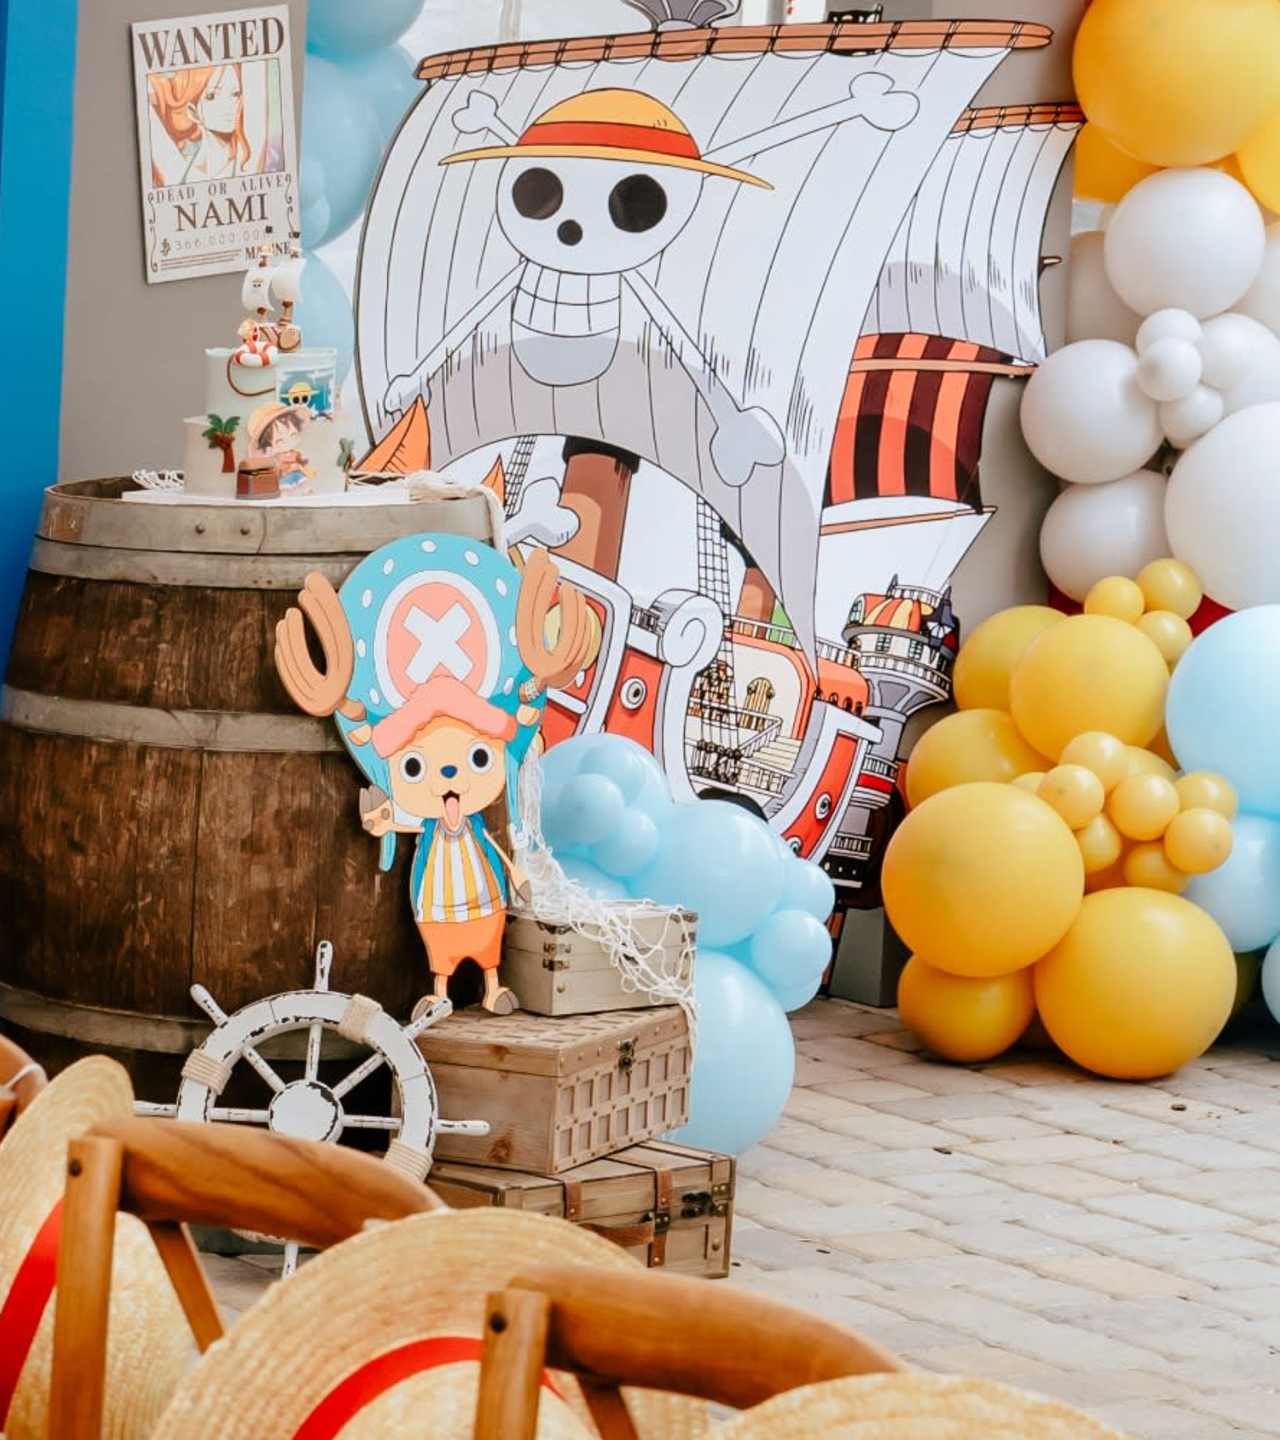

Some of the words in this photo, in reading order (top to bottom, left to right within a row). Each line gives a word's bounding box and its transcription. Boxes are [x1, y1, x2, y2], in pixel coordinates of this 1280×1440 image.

[137, 16, 285, 70] WANTED
[155, 188, 196, 204] DEAD
[208, 182, 227, 197] OR
[240, 174, 285, 192] ALIVE
[174, 194, 270, 233] NAMI
